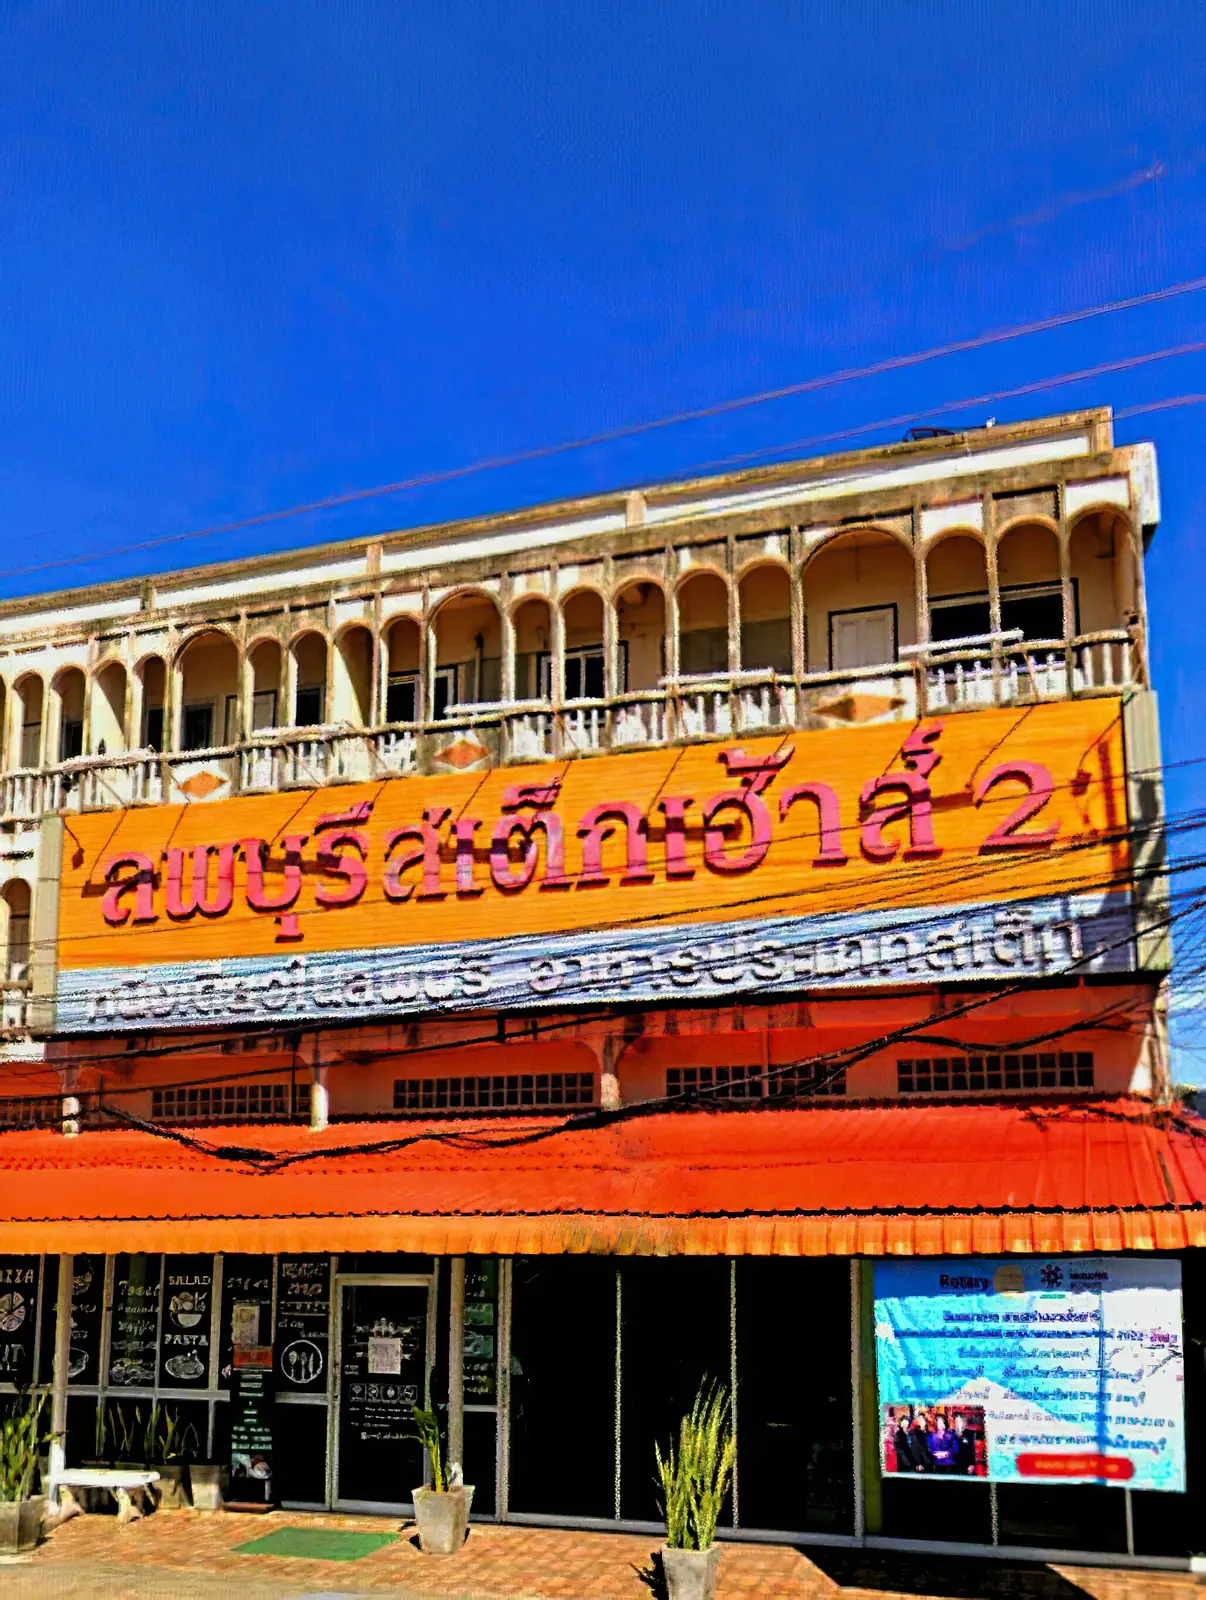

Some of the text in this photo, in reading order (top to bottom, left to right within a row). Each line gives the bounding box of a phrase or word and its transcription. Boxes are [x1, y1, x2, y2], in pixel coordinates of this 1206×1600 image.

[973, 759, 1061, 856] 2
[168, 1275, 211, 1286] SALAD
[939, 1273, 989, 1291] Rotary
[164, 1333, 209, 1347] PASTA
